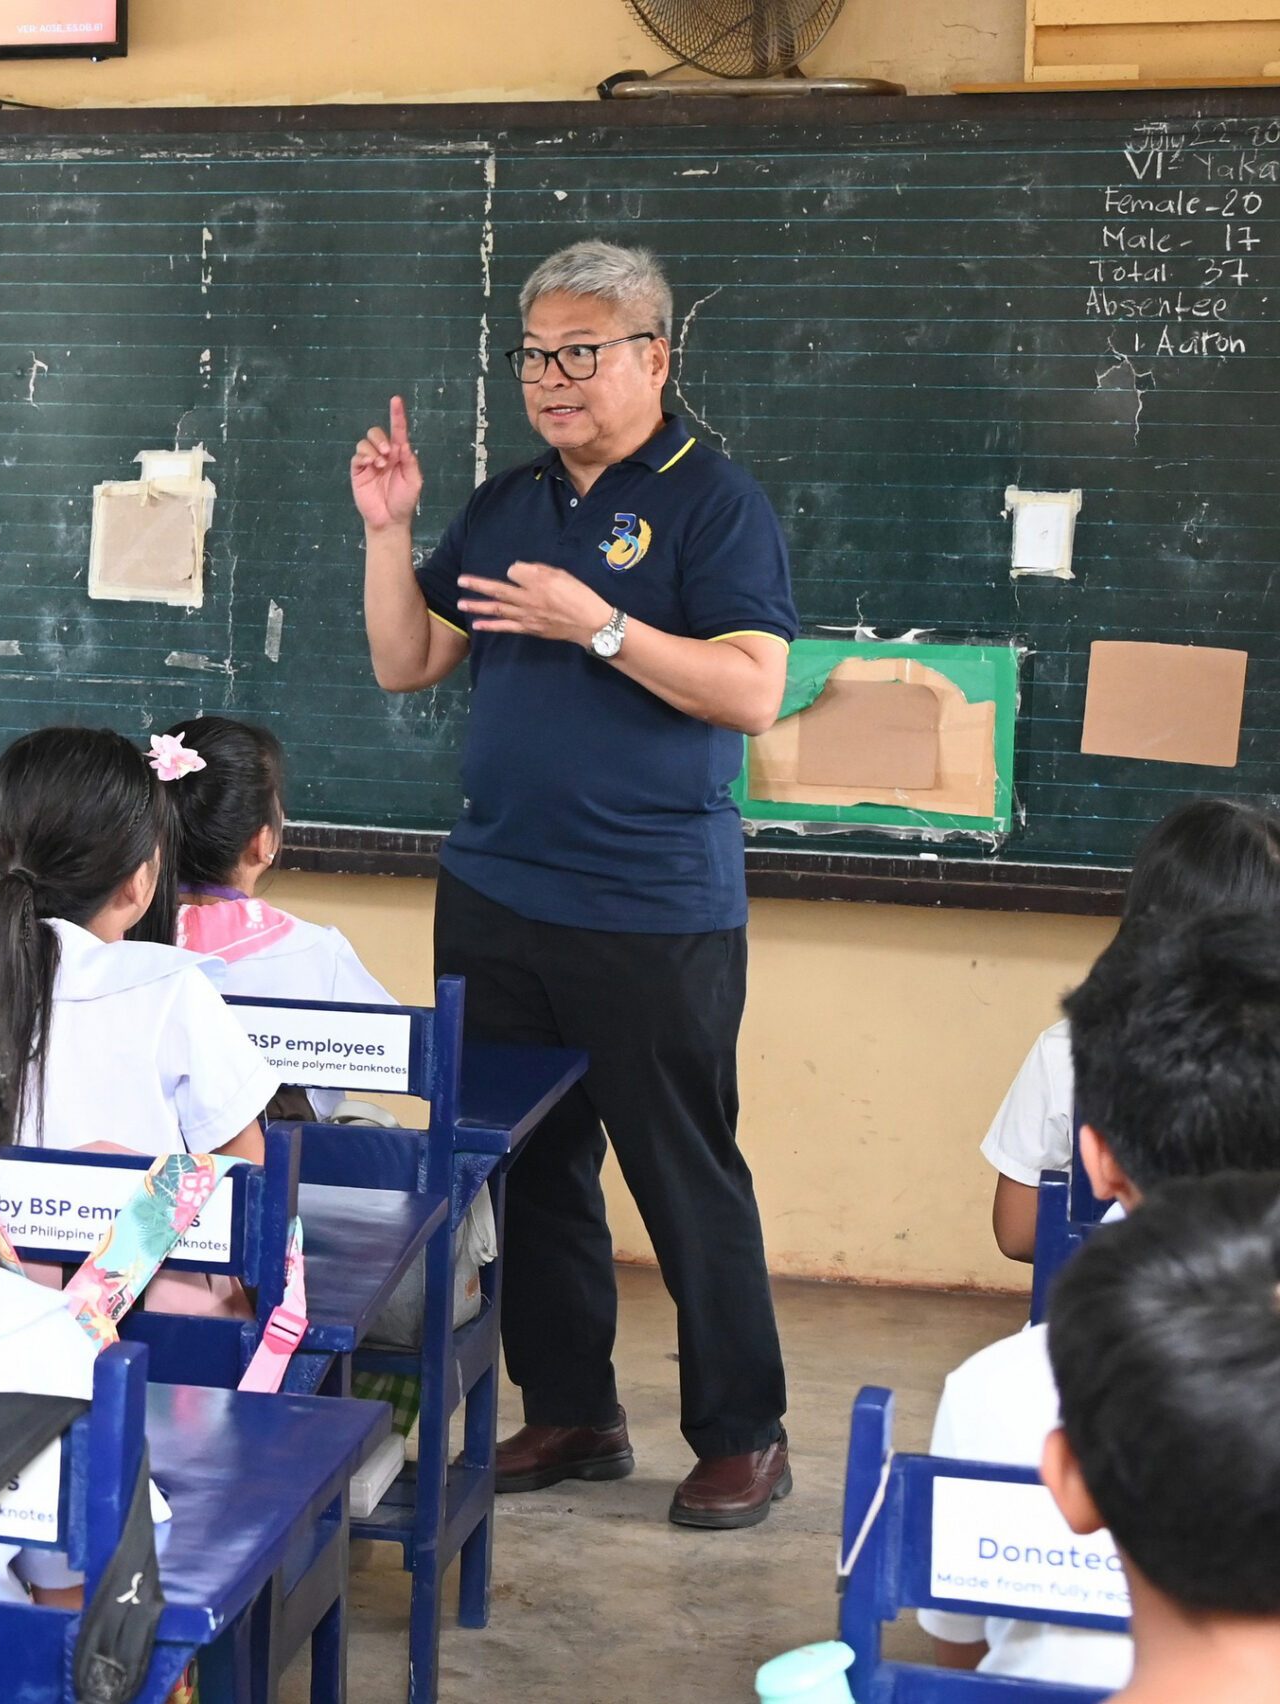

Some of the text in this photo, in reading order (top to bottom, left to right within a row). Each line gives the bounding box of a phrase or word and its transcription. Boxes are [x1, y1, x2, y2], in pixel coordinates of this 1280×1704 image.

[1225, 224, 1261, 251] 17
[286, 1039, 384, 1057] employees
[302, 1060, 347, 1071] polymer
[349, 1063, 406, 1074] banknotes
[30, 1198, 71, 1216] BSP
[30, 1225, 94, 1240] Philippine
[936, 1573, 989, 1588] Made
[997, 1576, 1042, 1592] from
